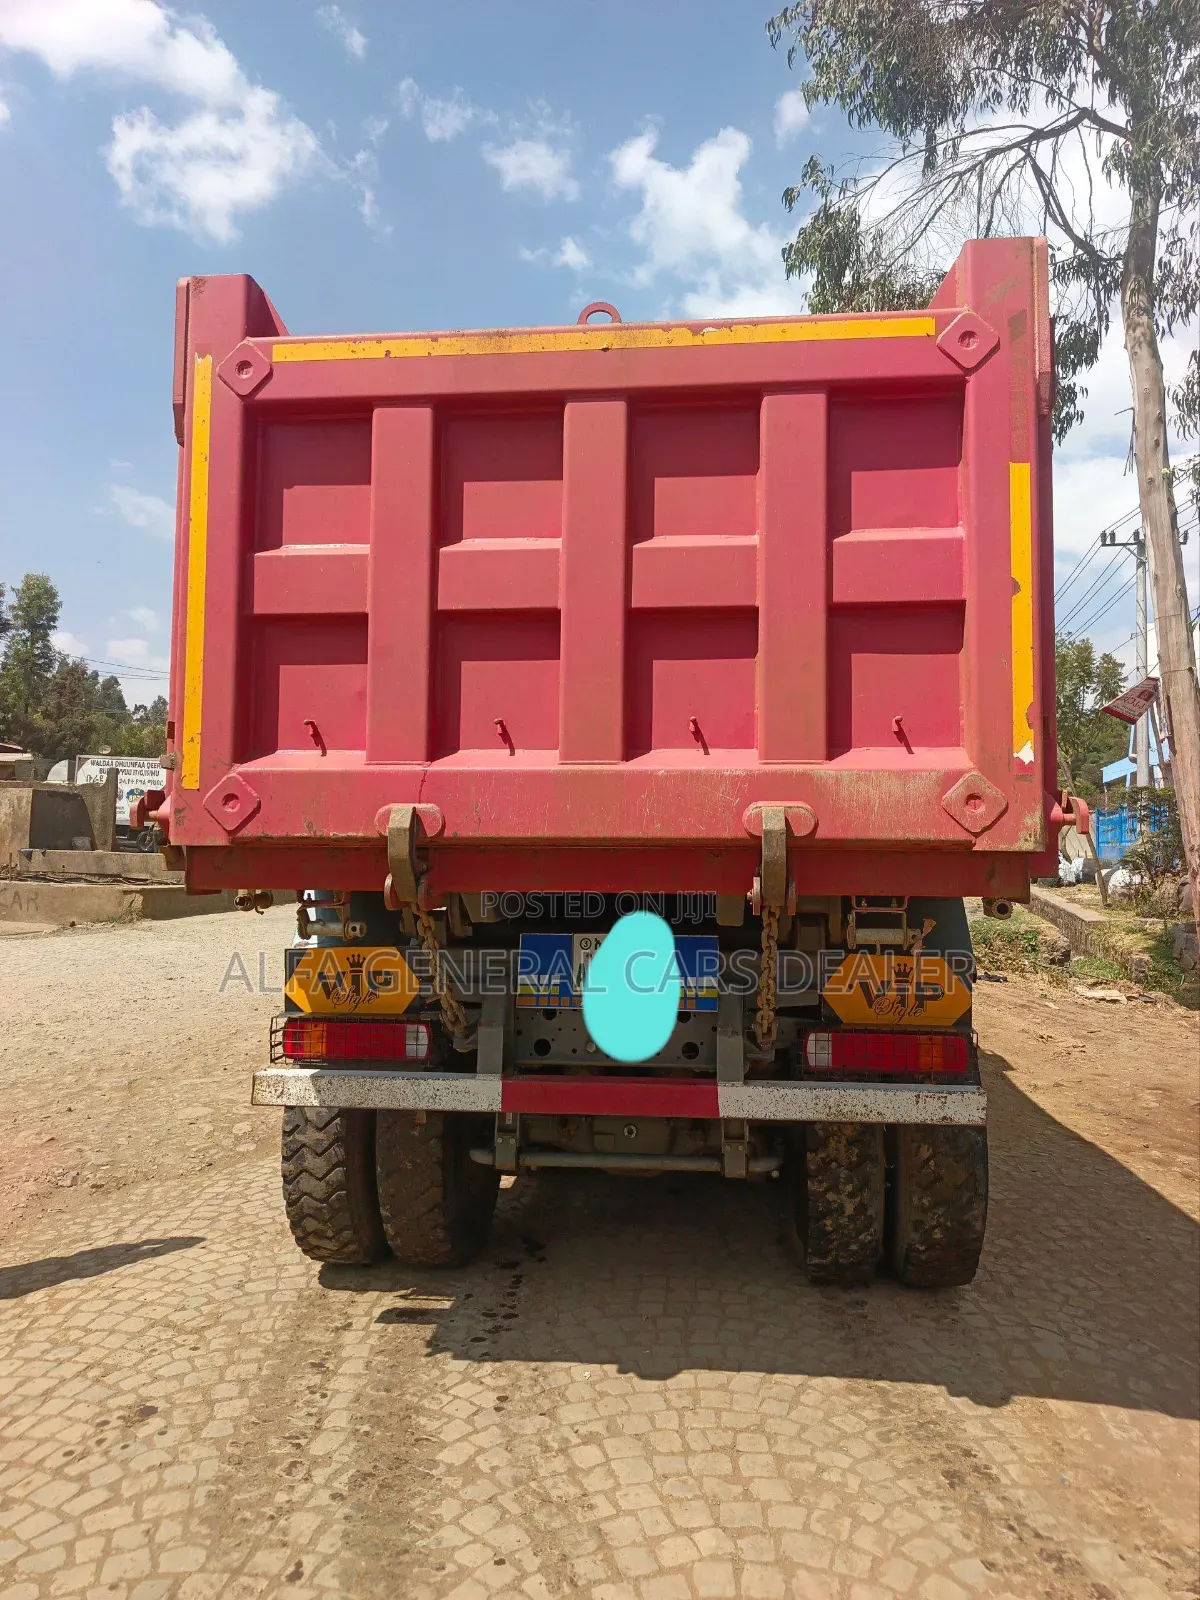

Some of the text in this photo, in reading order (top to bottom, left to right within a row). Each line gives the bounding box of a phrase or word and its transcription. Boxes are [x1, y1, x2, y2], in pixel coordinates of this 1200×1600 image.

[330, 985, 379, 1013] Style
[858, 980, 945, 1012] VIP
[872, 995, 924, 1026] Style
